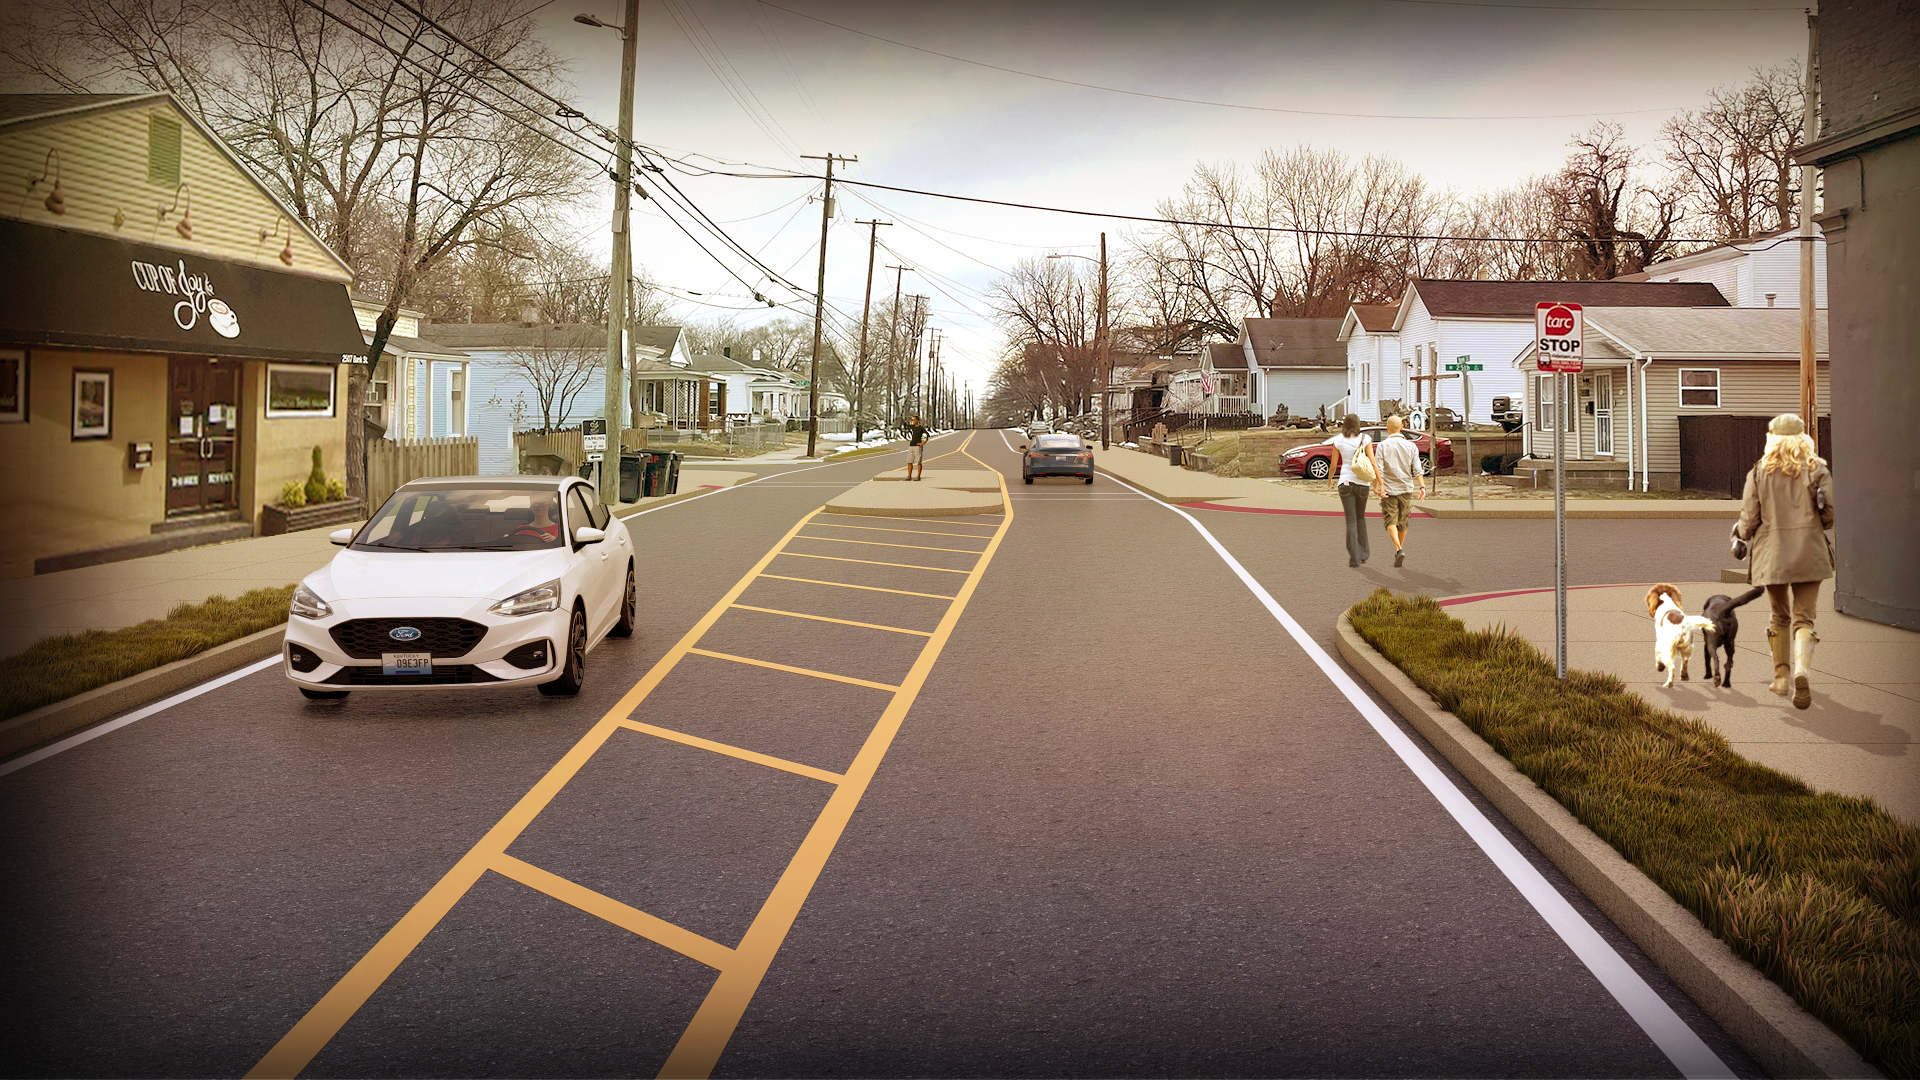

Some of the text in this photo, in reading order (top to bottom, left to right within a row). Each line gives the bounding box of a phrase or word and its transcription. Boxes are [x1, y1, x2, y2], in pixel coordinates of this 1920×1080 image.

[131, 260, 161, 293] CUP
[158, 264, 179, 296] OF
[1546, 315, 1573, 329] tarc
[1540, 338, 1580, 352] STOP
[396, 629, 414, 638] Ford
[396, 658, 429, 668] 09E3FP
